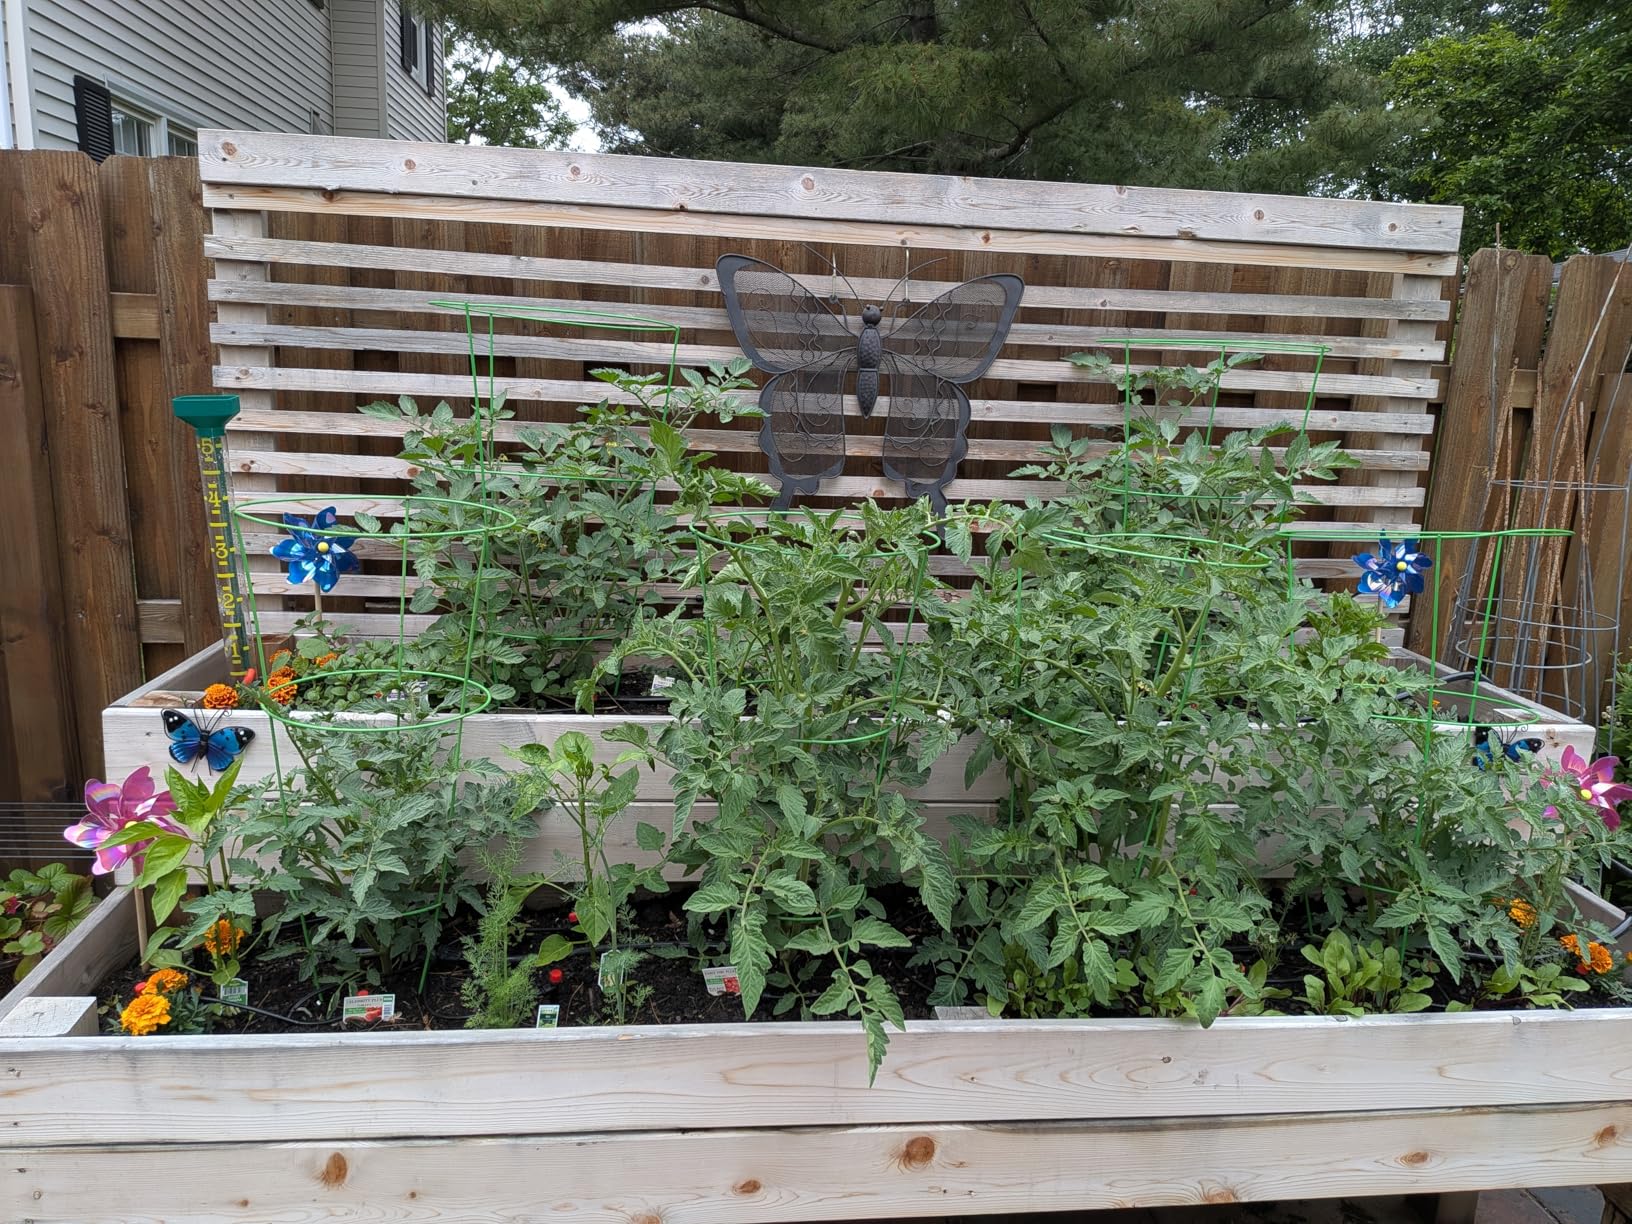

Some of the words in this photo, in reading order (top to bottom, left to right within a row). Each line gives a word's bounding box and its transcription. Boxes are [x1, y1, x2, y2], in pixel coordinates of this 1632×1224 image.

[201, 437, 214, 455] 5
[208, 491, 222, 508] 4
[215, 542, 229, 559] 3
[222, 593, 236, 609] 2
[230, 640, 241, 658] 1
